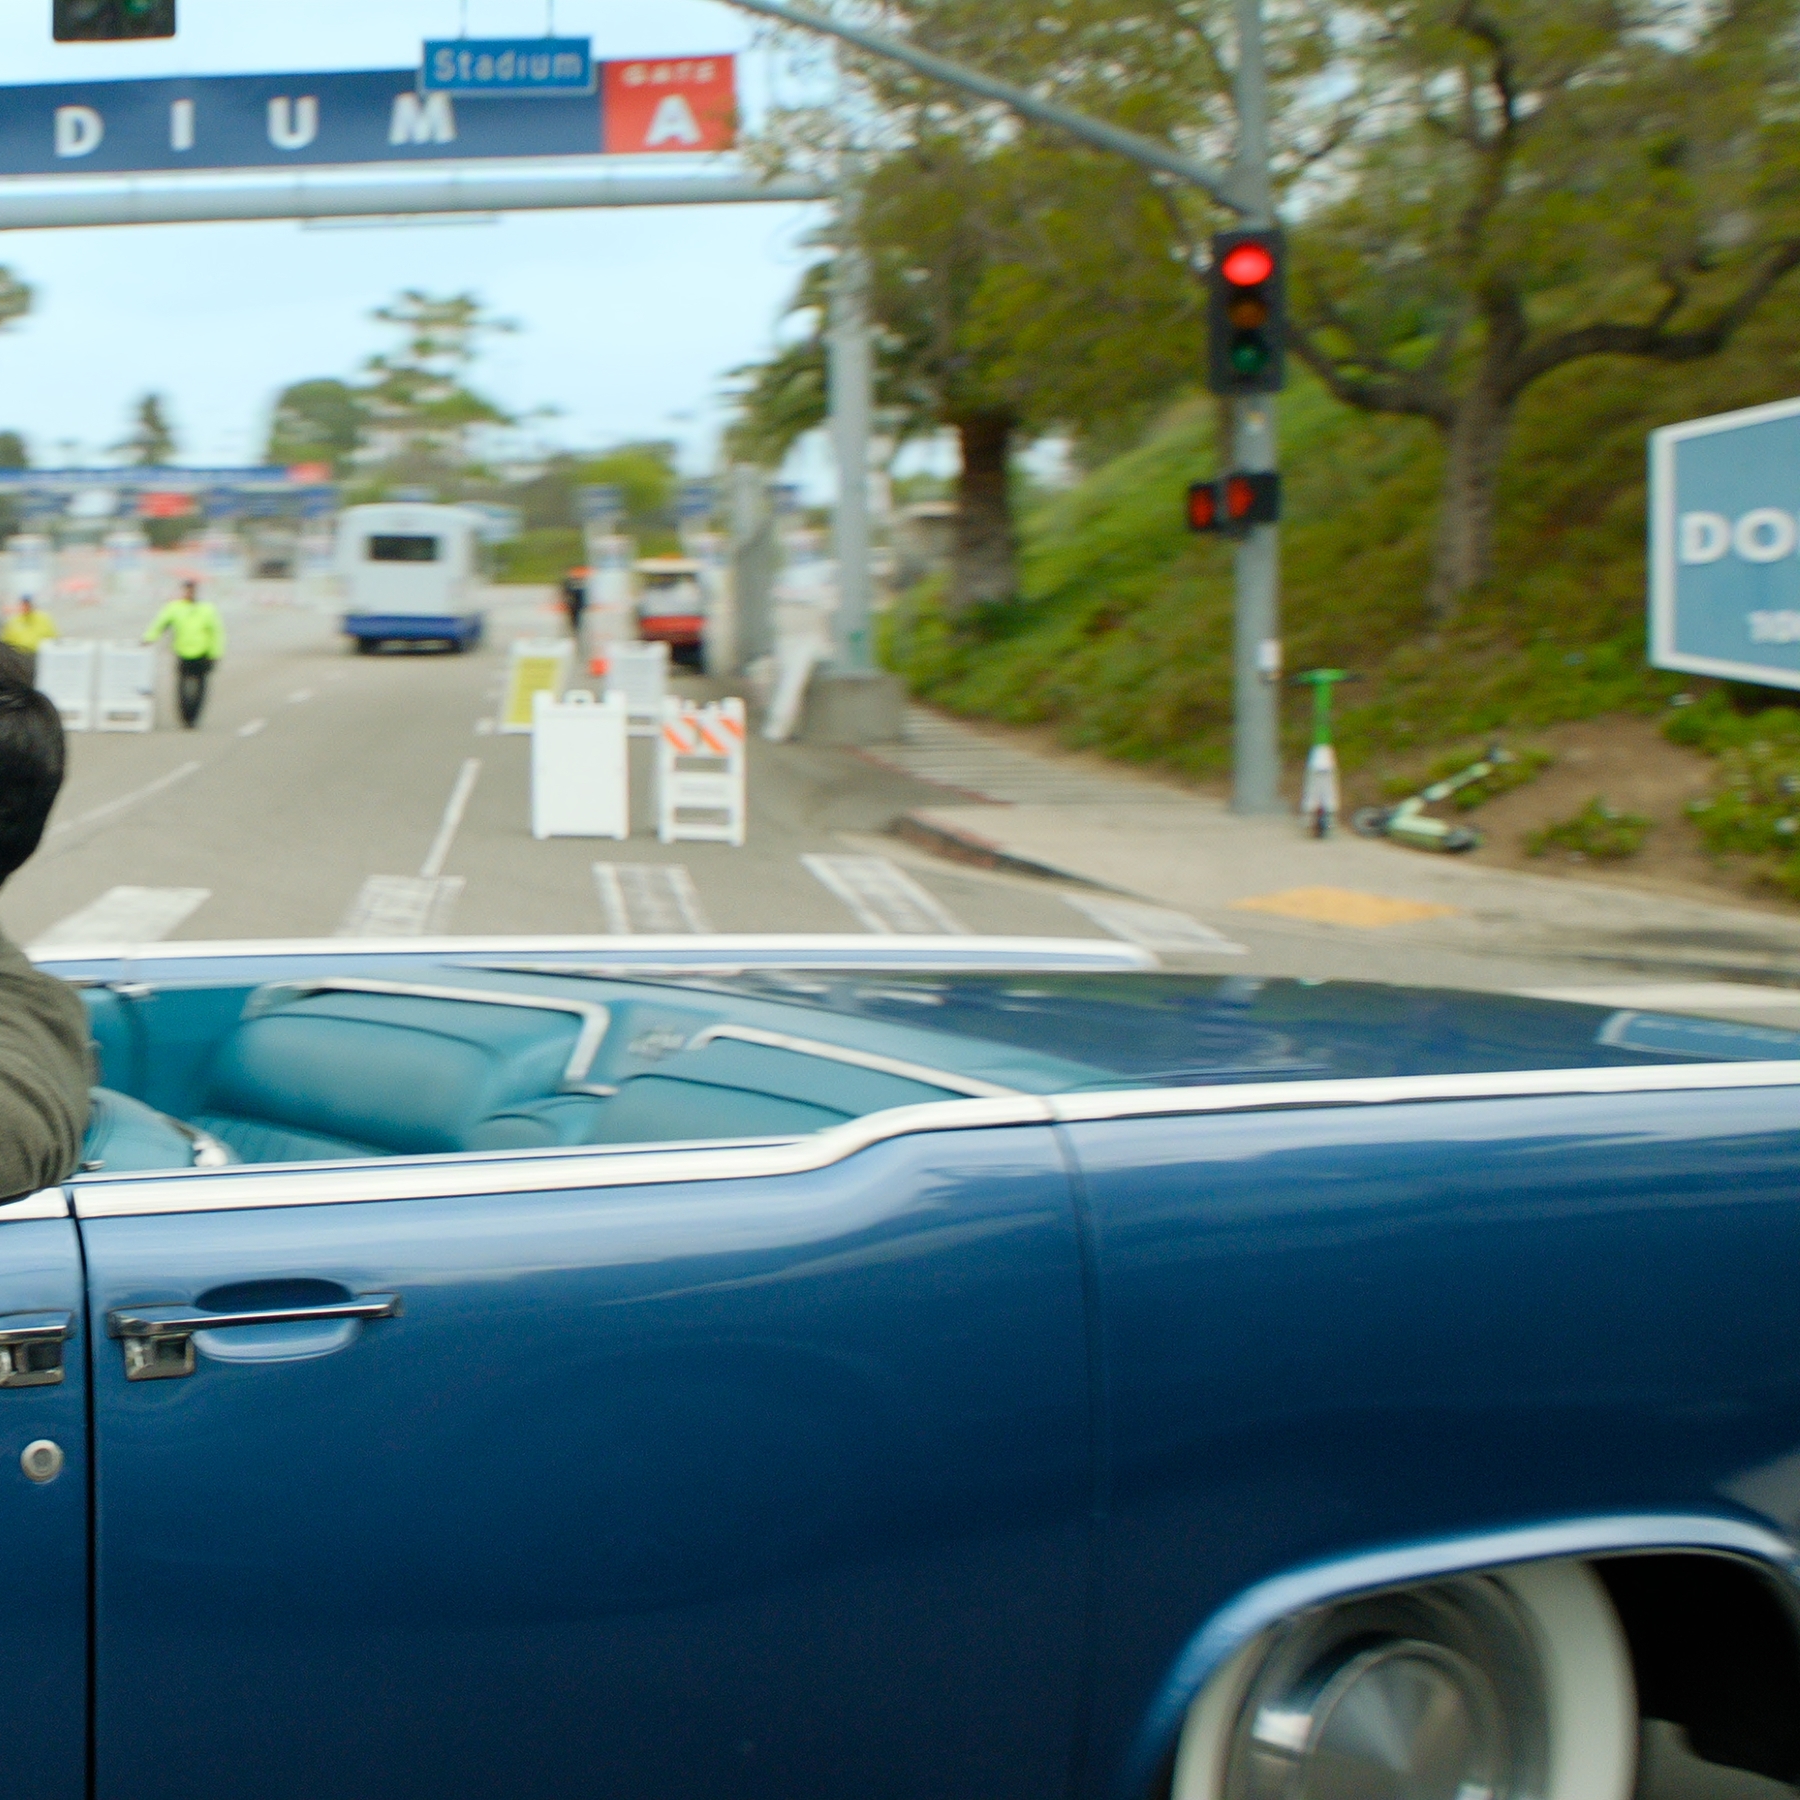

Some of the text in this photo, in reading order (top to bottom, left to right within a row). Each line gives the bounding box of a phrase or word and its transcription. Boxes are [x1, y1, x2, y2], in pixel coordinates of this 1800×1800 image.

[433, 48, 584, 82] Stadium
[644, 94, 701, 146] A
[1678, 507, 1800, 565] DO
